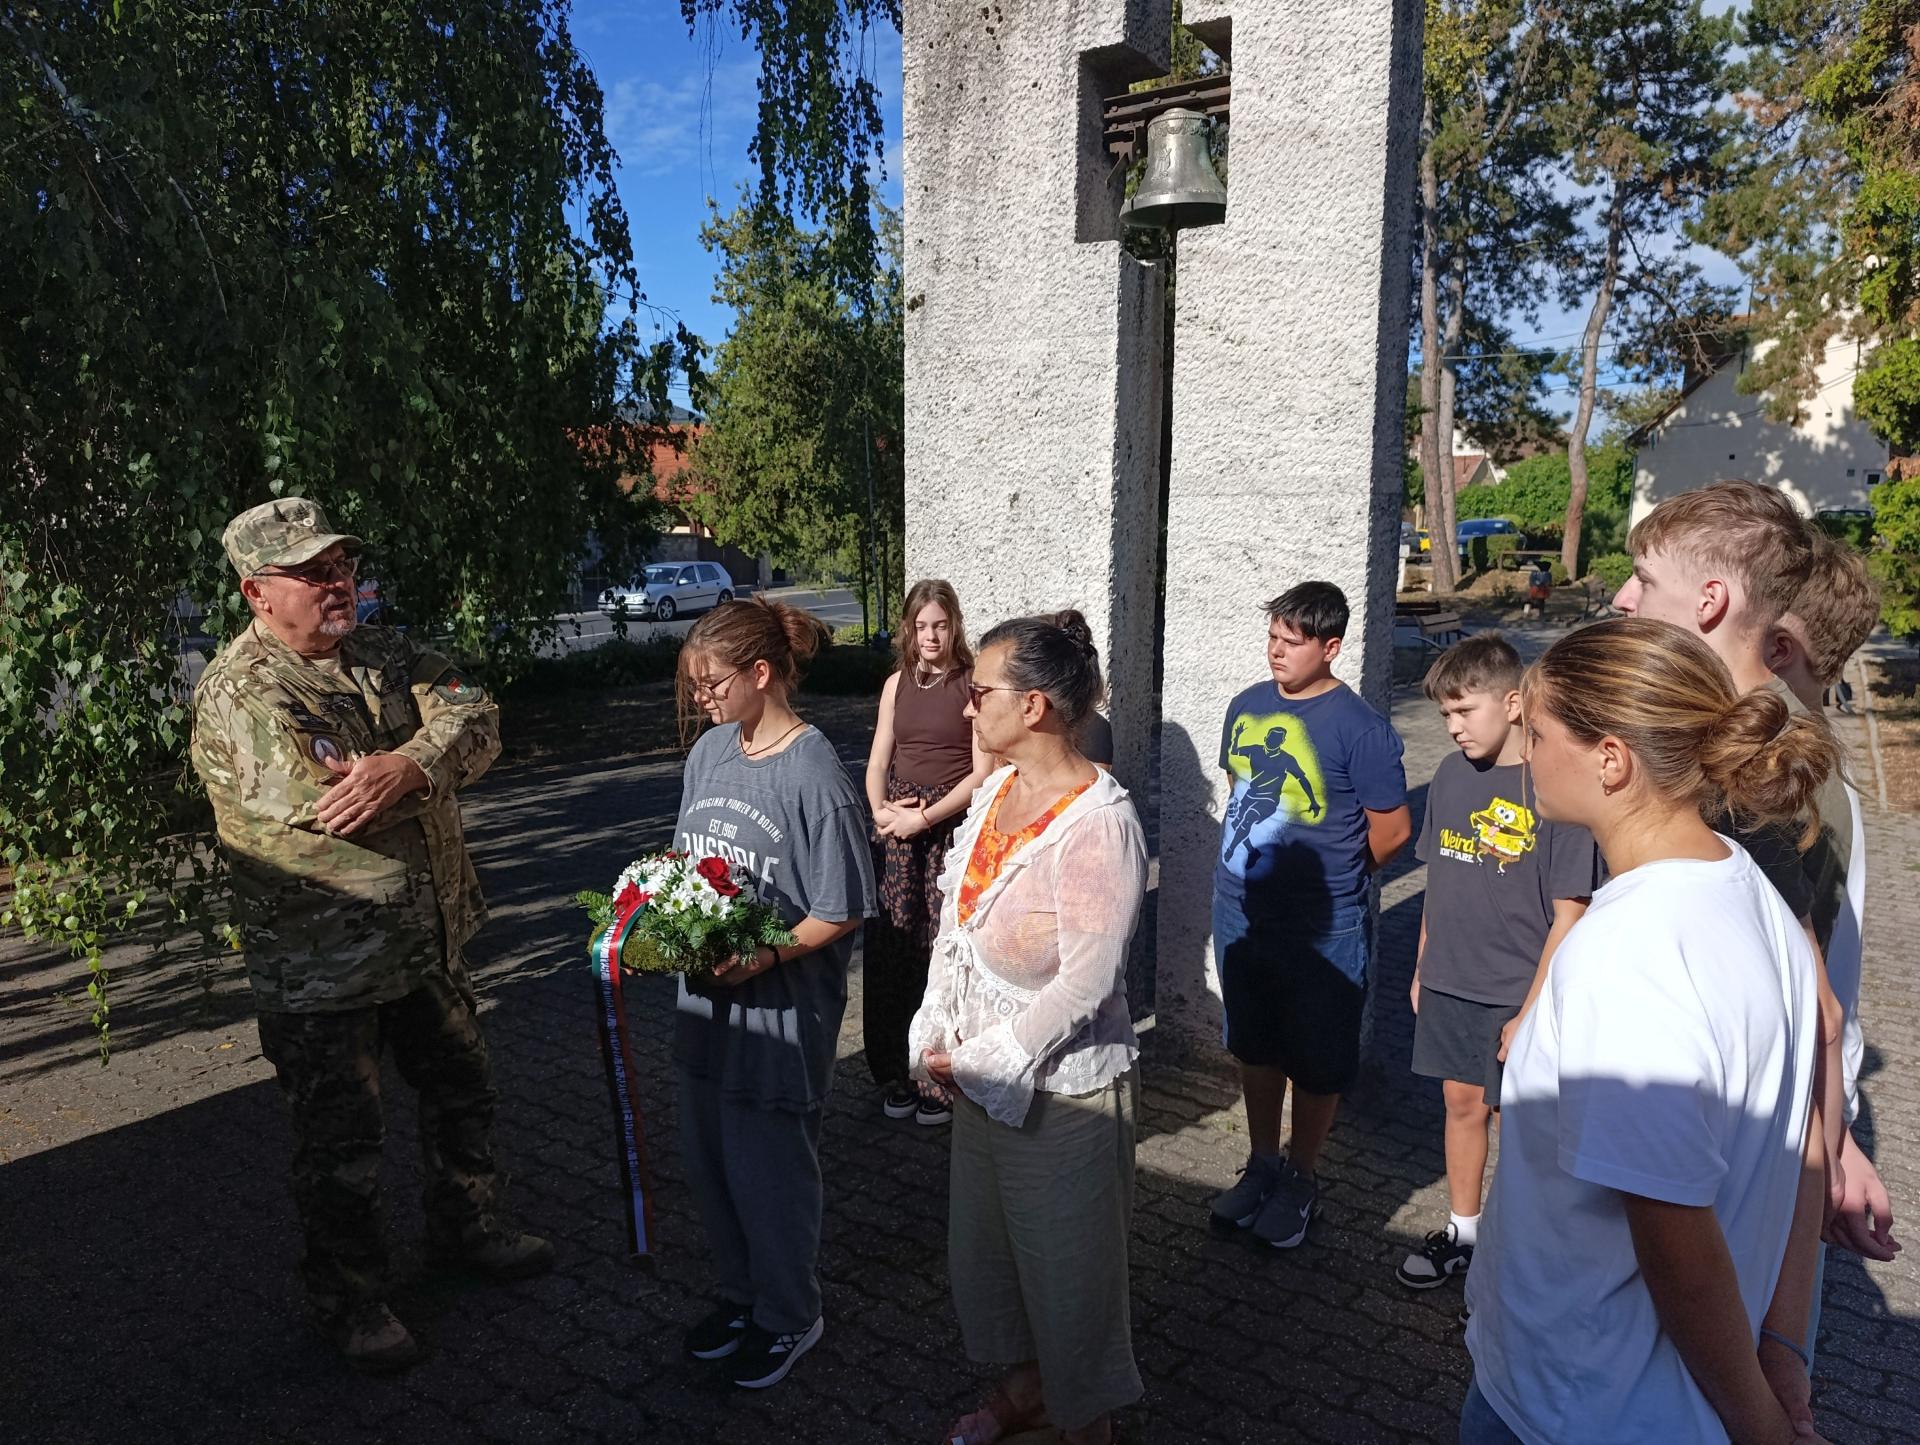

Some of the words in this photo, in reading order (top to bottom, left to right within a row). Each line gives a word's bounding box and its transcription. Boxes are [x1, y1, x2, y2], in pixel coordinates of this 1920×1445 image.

[696, 797, 727, 810] ORIGINAL
[726, 798, 752, 815] PIONEER
[749, 808, 760, 820] IN
[757, 814, 784, 843] BOXING
[721, 822, 738, 839] 1960
